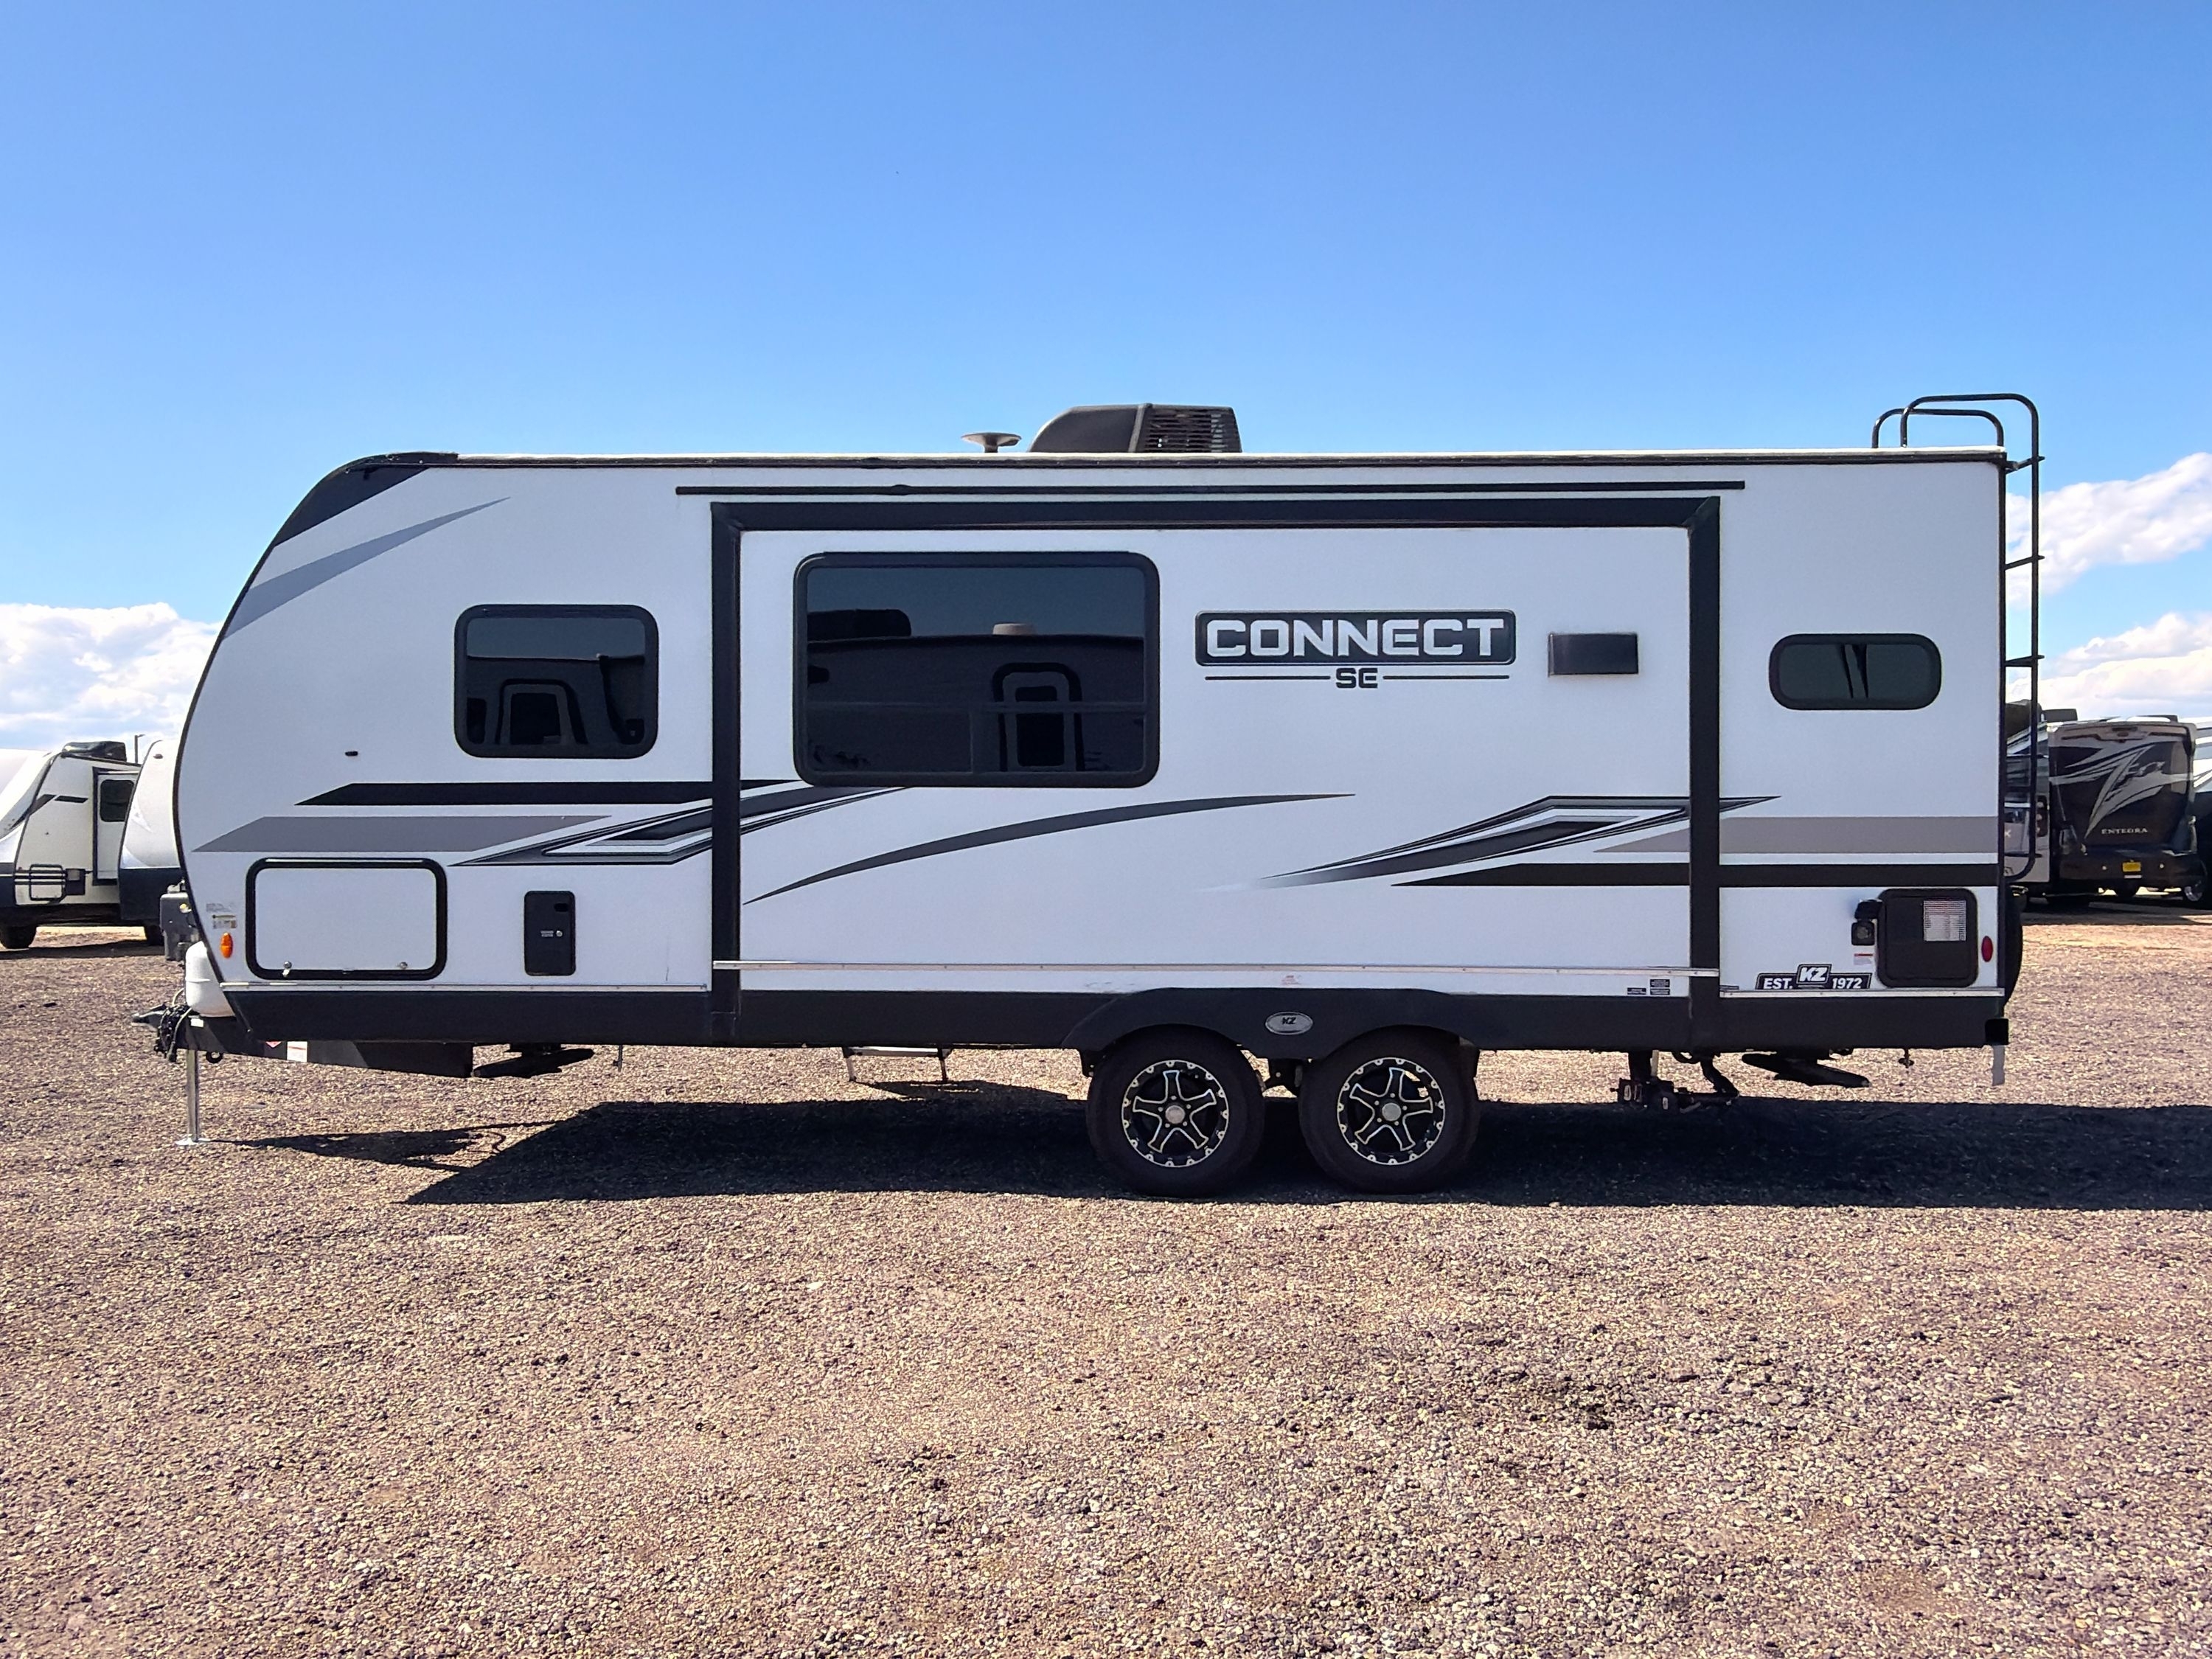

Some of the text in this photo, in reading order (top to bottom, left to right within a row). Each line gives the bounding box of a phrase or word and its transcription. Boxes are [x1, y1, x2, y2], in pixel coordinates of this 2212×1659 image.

[1206, 619, 1504, 657] CONNECT
[1335, 667, 1378, 689] SE
[1763, 967, 1862, 990] EST. KZ 1972
